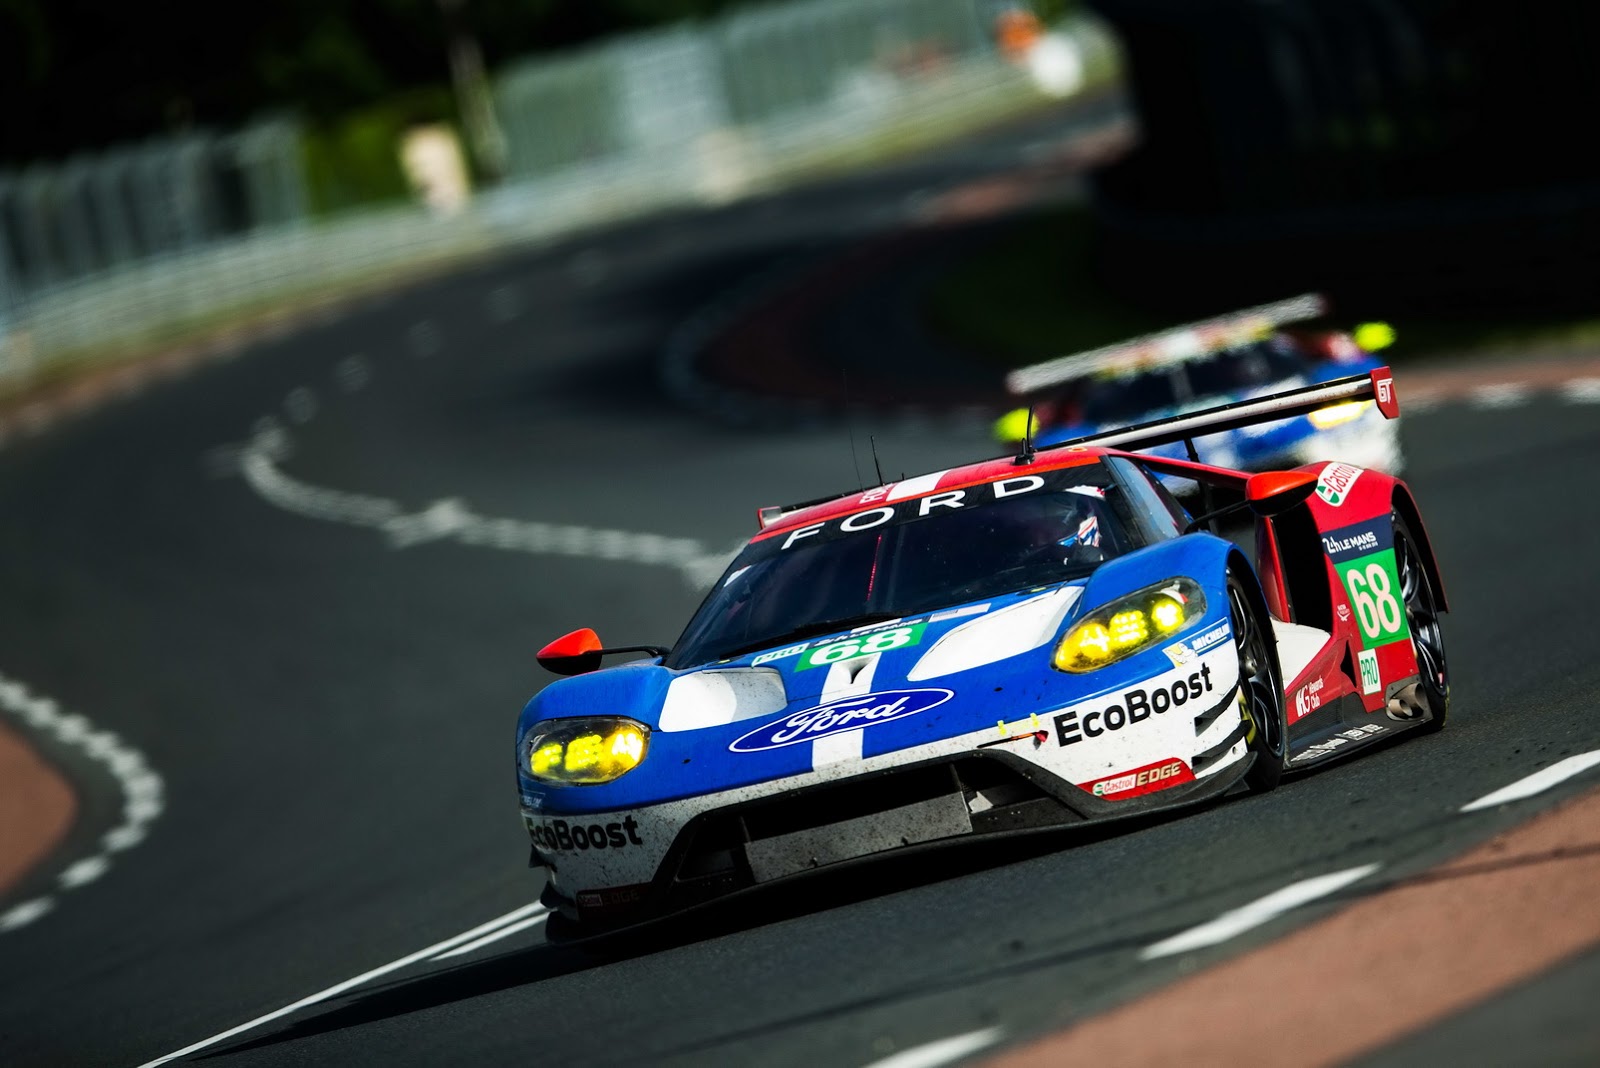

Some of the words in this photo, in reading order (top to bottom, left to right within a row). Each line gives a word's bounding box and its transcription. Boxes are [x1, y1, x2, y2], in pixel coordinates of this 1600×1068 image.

[1377, 378, 1393, 404] GT
[781, 475, 1045, 550] FORD
[1339, 539, 1351, 550] LE
[1350, 531, 1377, 547] MANS
[1347, 564, 1401, 638] 68
[809, 627, 913, 665] 68
[1191, 623, 1231, 650] MICHELIN
[755, 644, 804, 663] PRO
[1361, 656, 1379, 686] PRO
[771, 696, 911, 743] Ford
[1053, 662, 1213, 747] EcoBoost
[1103, 777, 1134, 793] Castrol
[1136, 761, 1183, 787] EDGE
[526, 815, 643, 850] EcoBoost
